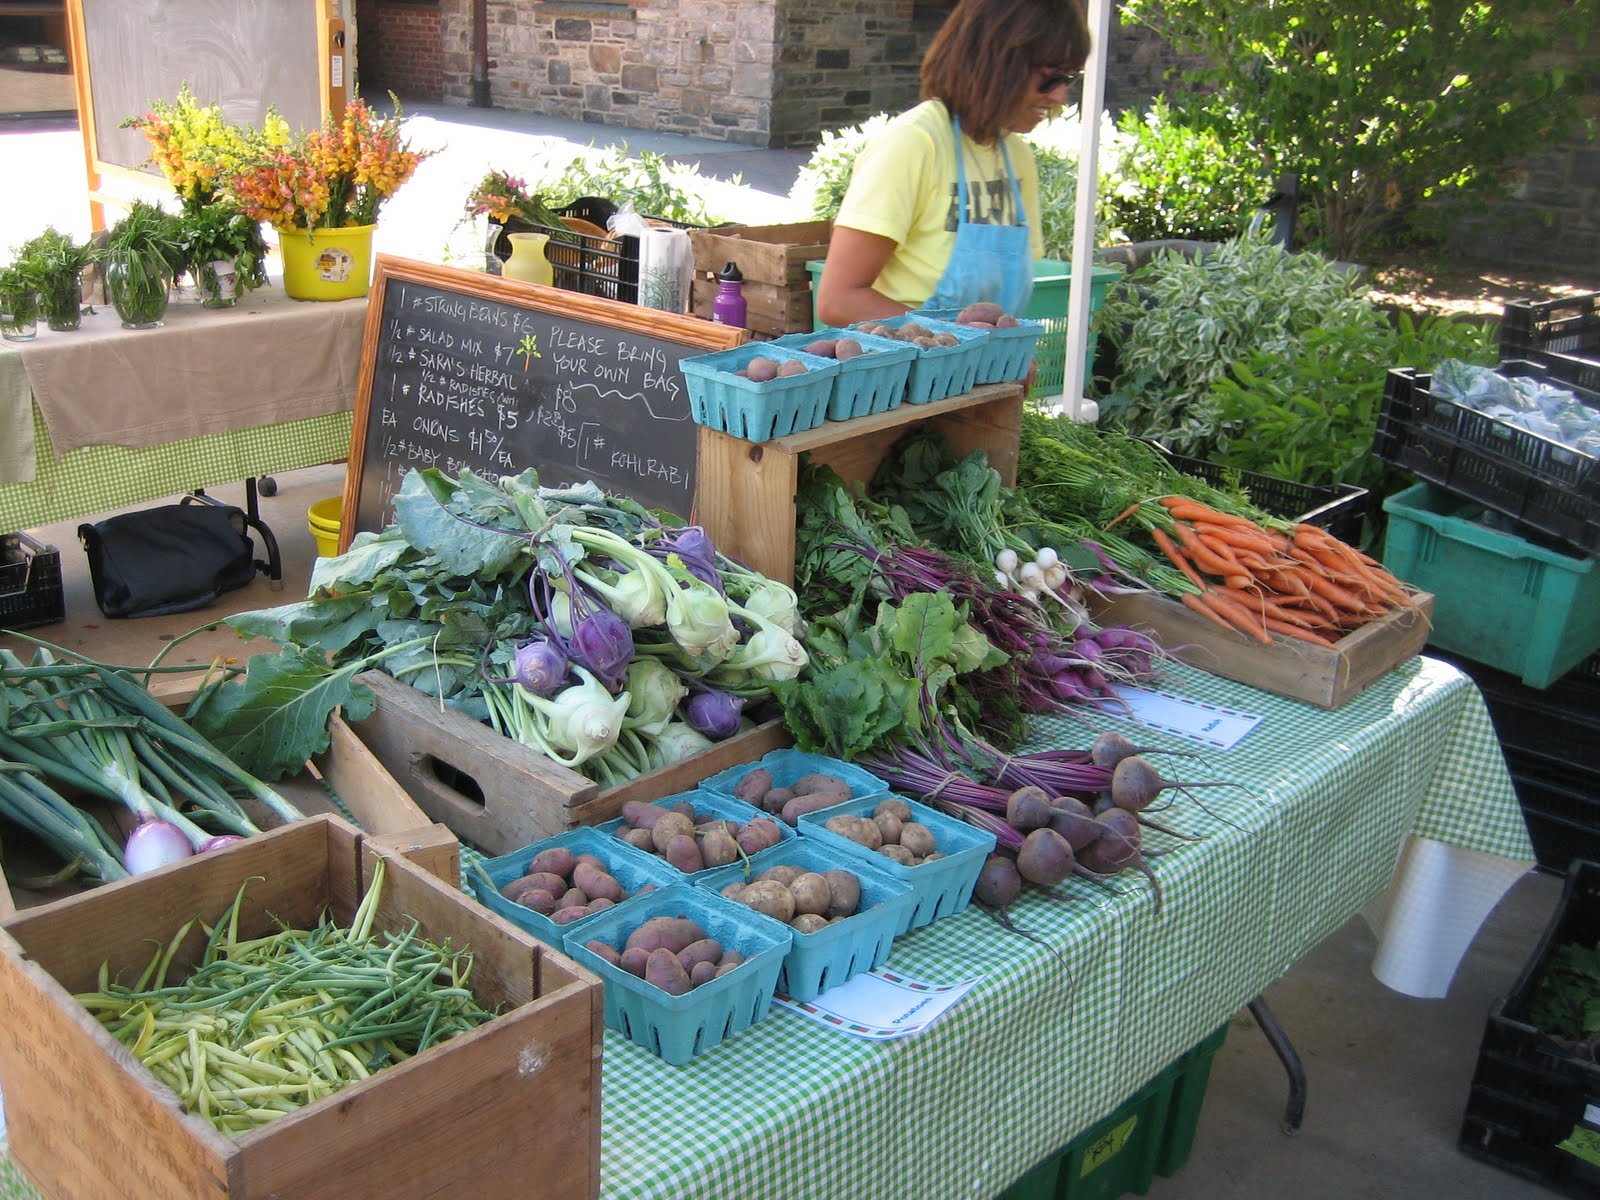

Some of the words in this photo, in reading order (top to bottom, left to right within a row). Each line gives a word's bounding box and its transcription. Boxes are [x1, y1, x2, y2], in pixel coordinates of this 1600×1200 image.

[424, 296, 466, 322] STRING
[469, 302, 508, 327] BEANS
[513, 312, 534, 334] $6
[418, 328, 454, 348] SALAD
[461, 338, 483, 357] MIX
[494, 341, 515, 365] $7
[549, 326, 608, 355] PLEASE
[617, 341, 667, 373] BRING
[419, 349, 466, 377] SARA'S
[470, 364, 518, 390] HERBAL
[555, 383, 577, 413] $8
[553, 352, 588, 375] YOUR
[594, 364, 630, 383] OWN
[382, 407, 398, 428] EA
[418, 382, 485, 417] RADISHES
[496, 402, 519, 430] $5
[557, 419, 577, 449] $5
[407, 441, 442, 468] BABY
[611, 451, 689, 490] KOHLRABI
[891, 997, 934, 1024] Potatoes
